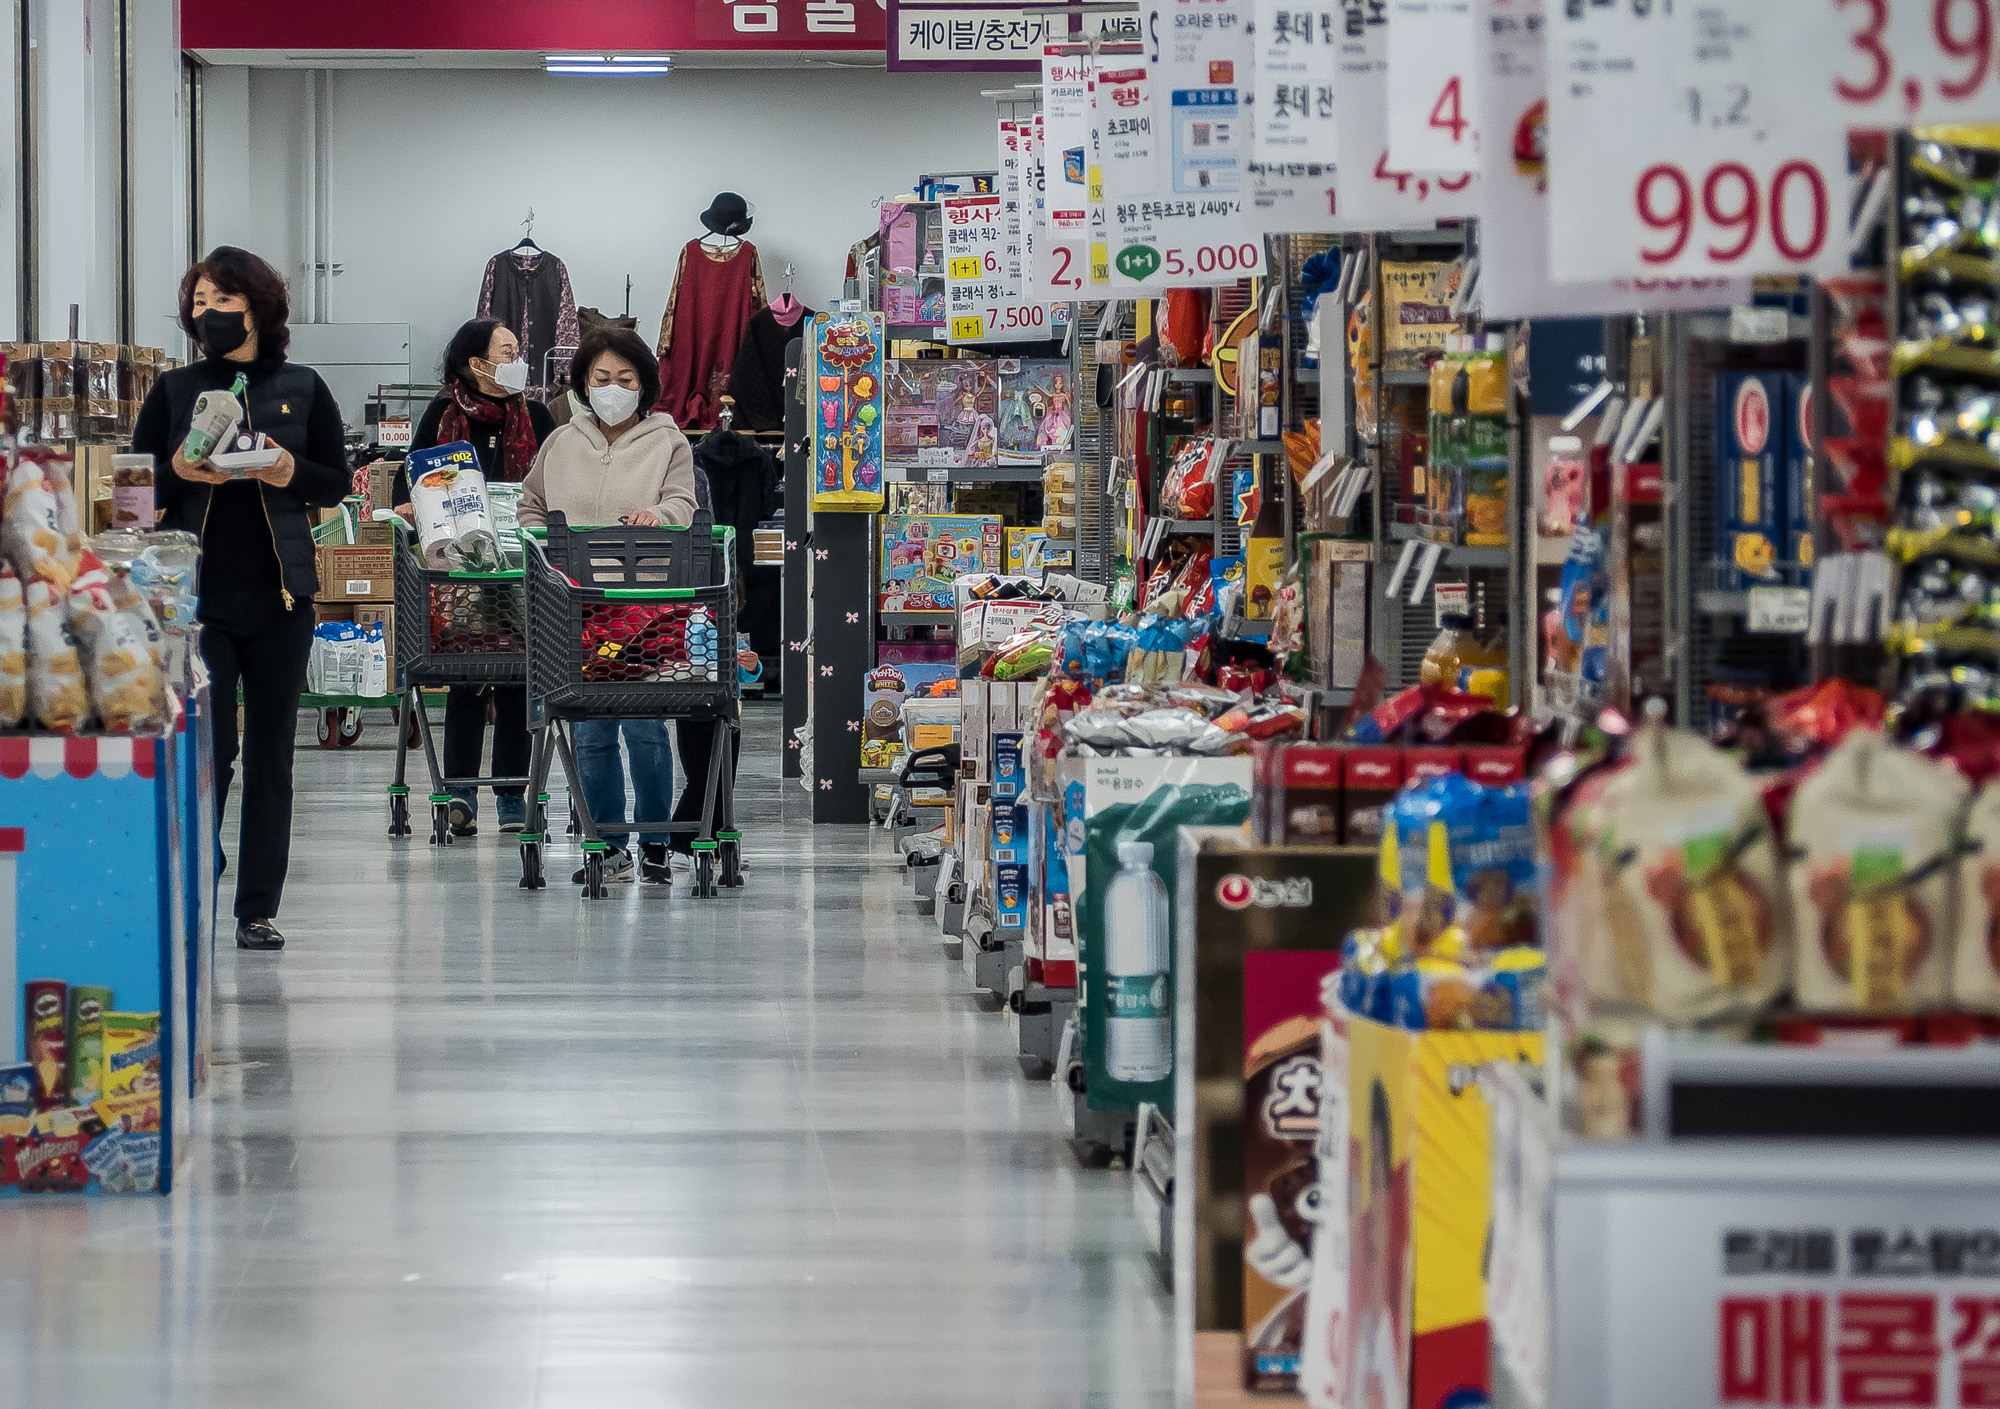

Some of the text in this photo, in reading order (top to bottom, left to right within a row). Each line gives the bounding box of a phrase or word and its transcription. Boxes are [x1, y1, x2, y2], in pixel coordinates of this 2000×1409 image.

[909, 19, 1050, 51] 케이블/충전기
[1107, 116, 1151, 136] 초코파이
[1005, 201, 1020, 213] 롯
[1635, 160, 1829, 265] 990
[948, 227, 1000, 244] 클래식 직2
[952, 260, 978, 277] 1+1
[1122, 252, 1154, 271] 1+1
[1165, 243, 1259, 276] 5,000
[951, 285, 984, 301] 클래식
[986, 304, 1044, 331] 7,500
[954, 318, 981, 337] 1+1
[380, 432, 410, 441] 10,000
[870, 668, 903, 680] Play-Doh
[875, 681, 899, 689] WHEELS
